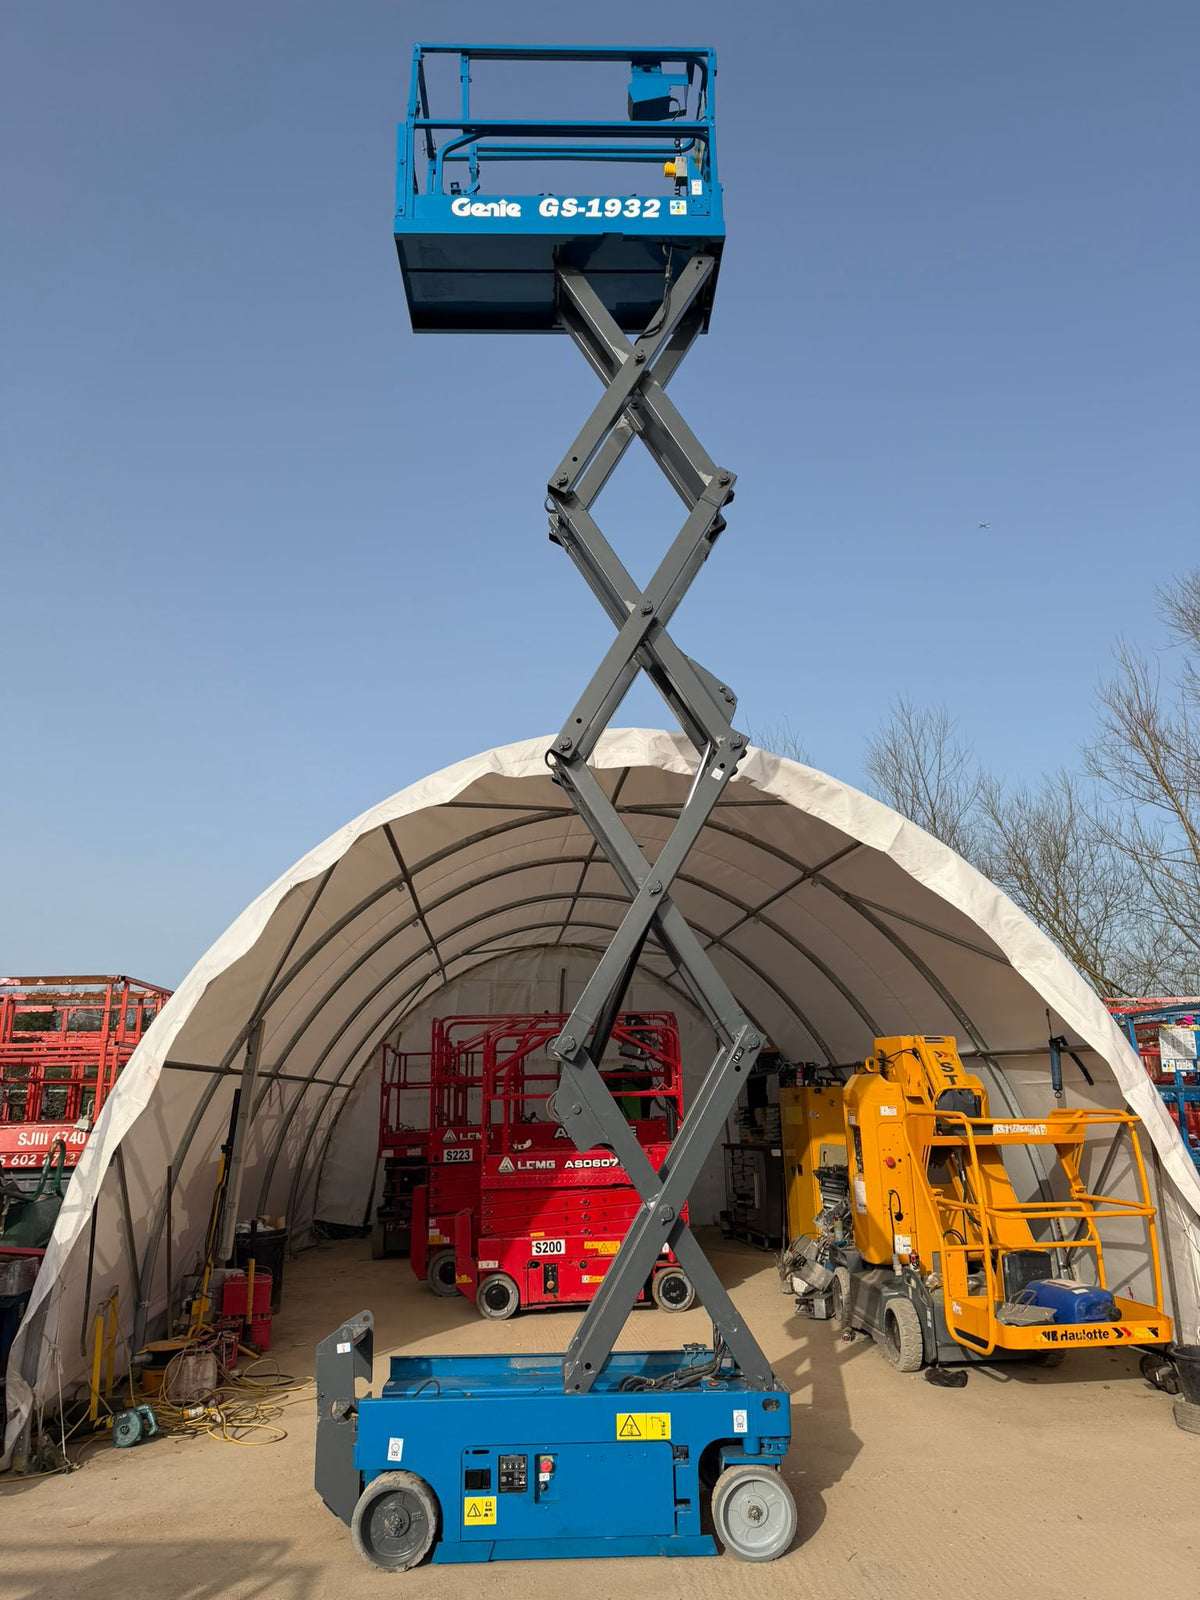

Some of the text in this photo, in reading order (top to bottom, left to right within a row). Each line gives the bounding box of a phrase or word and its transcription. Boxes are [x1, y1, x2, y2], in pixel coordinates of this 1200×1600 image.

[451, 197, 661, 218] Genie GS-1932
[10, 1154, 37, 1165] 602
[446, 1150, 470, 1160] S223
[535, 1241, 562, 1253] S200
